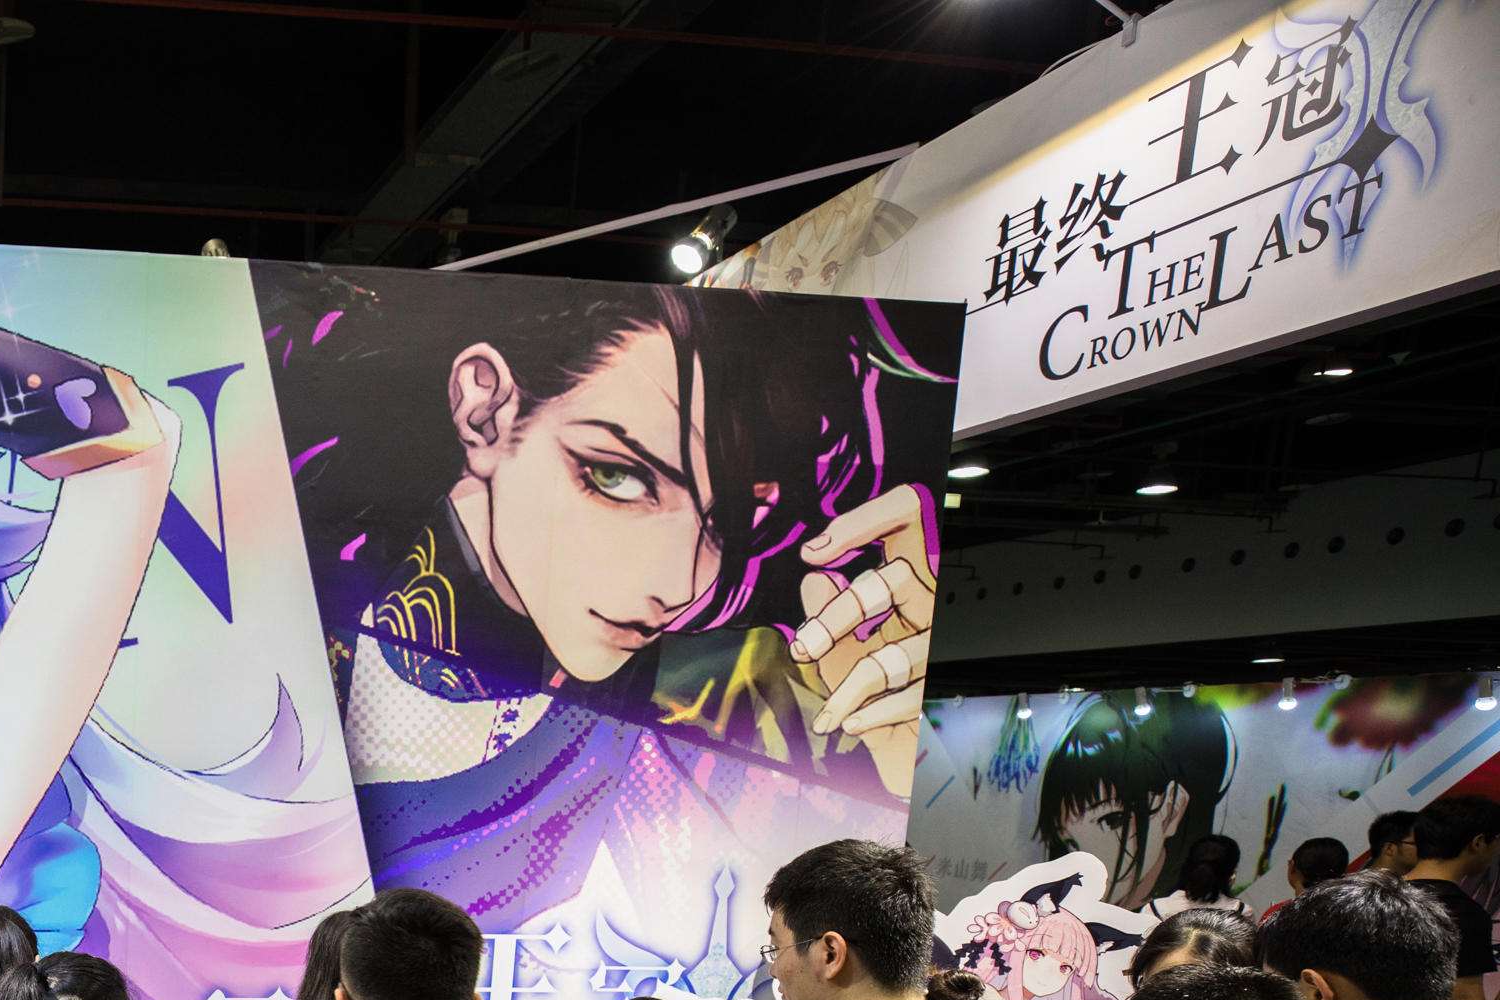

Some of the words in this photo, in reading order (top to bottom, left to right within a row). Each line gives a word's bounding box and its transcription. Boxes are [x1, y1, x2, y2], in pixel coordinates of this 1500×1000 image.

[983, 14, 1362, 306] 最终王冠
[1101, 231, 1206, 321] THE
[1198, 172, 1384, 313] LAST
[1038, 302, 1204, 381] CROWN
